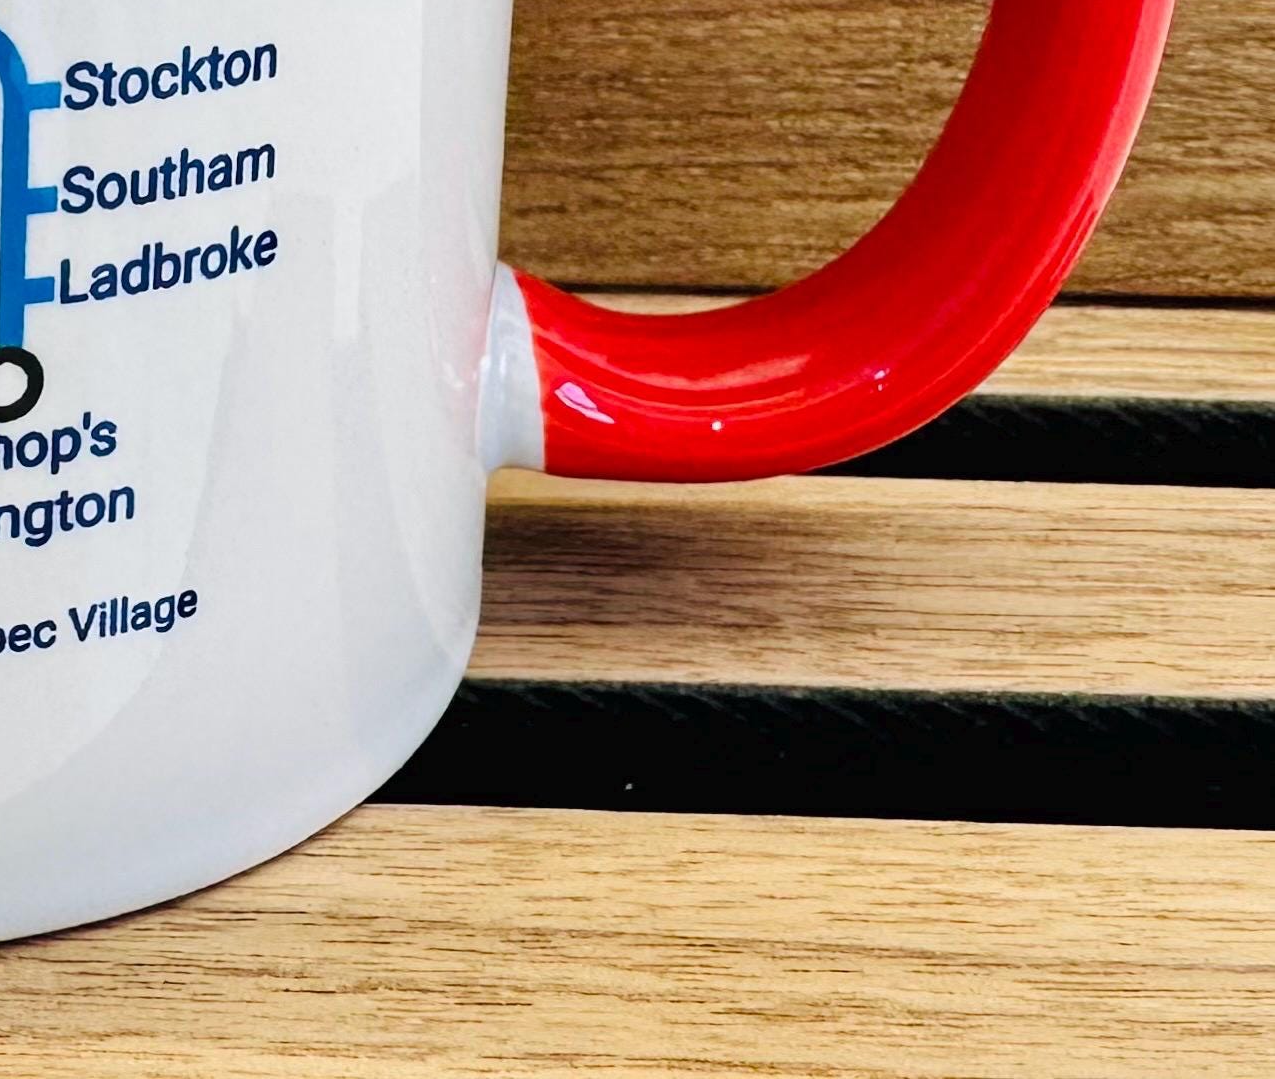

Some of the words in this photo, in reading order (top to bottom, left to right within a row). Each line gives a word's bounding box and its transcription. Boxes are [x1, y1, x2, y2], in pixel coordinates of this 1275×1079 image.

[63, 43, 278, 111] Stockton
[60, 143, 276, 215] Southam
[59, 225, 278, 305] Ladbroke
[68, 589, 198, 642] Village
